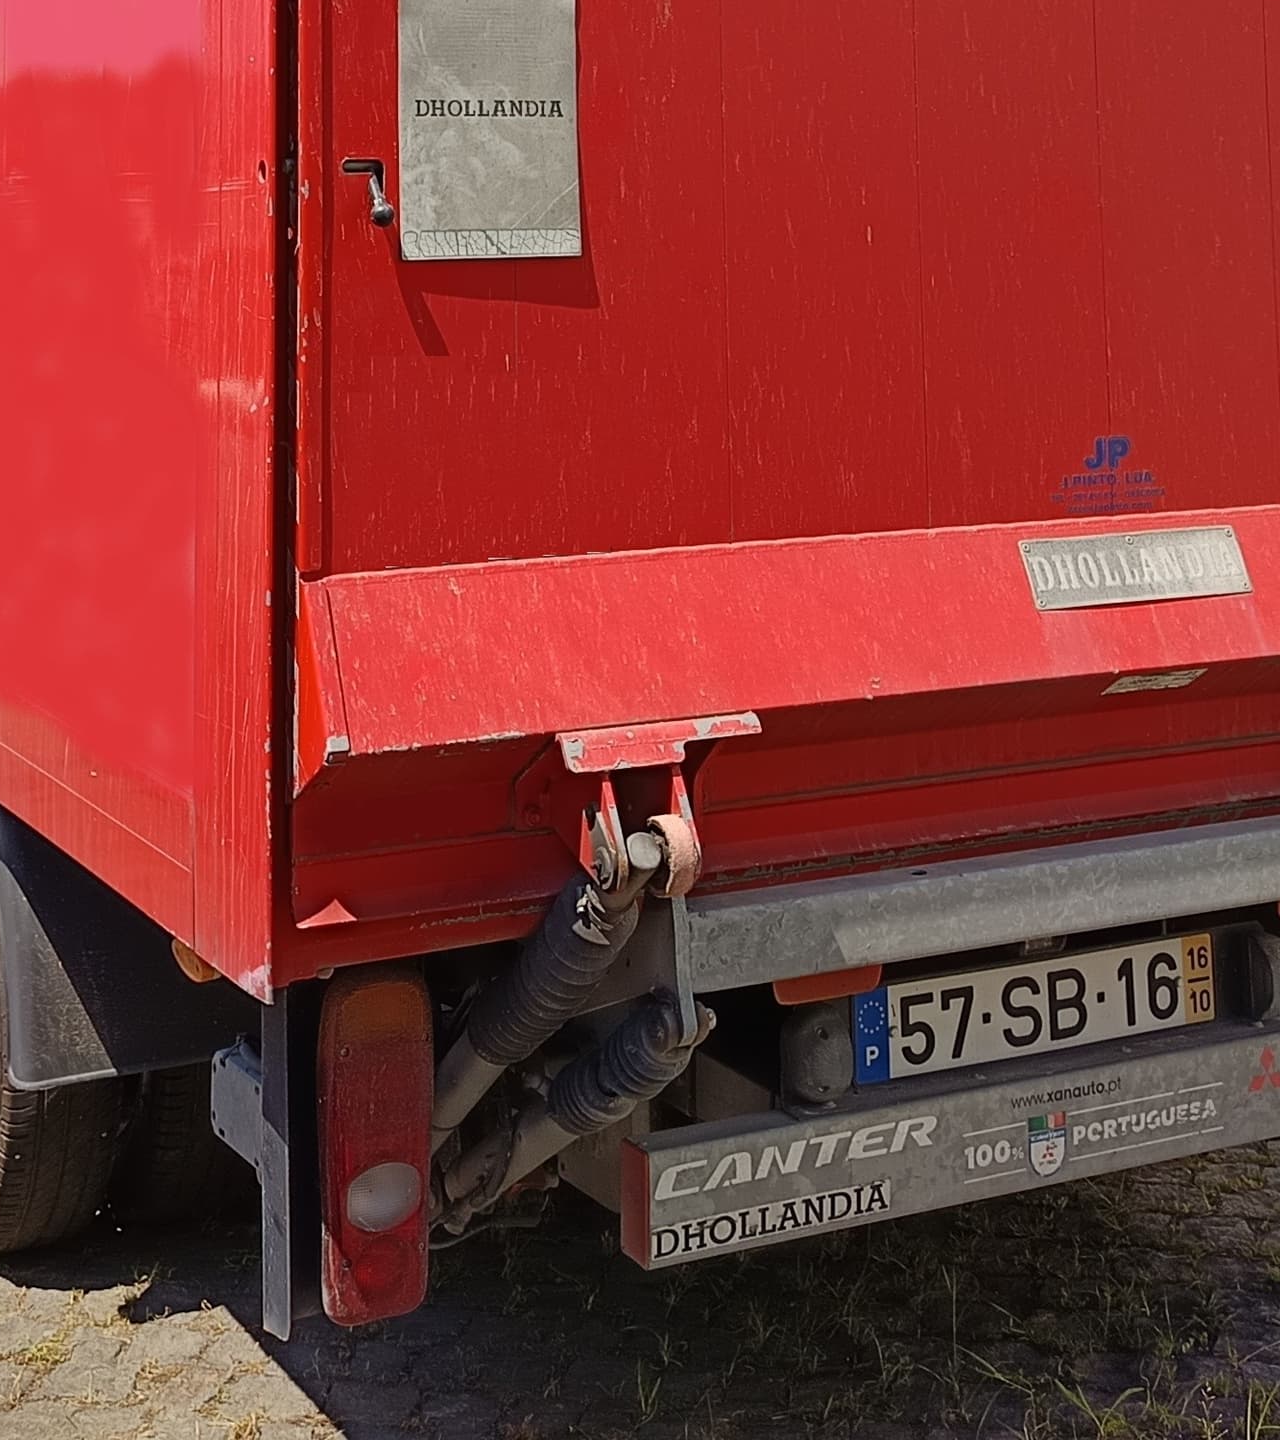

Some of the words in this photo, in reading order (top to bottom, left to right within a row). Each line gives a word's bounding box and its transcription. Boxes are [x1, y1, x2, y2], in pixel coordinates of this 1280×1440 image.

[414, 99, 565, 118] DHOLLANDIA
[1084, 435, 1131, 470] JP
[1028, 540, 1242, 594] DHOLLANDIA
[1186, 945, 1209, 971] 16
[1190, 987, 1211, 1014] 10
[865, 1046, 880, 1067] P
[1010, 1076, 1121, 1110] www.xanauto.pt
[963, 1139, 1024, 1170] 100%
[1072, 1098, 1217, 1146] PORTUGUESA
[654, 1115, 938, 1201] CANTER
[653, 1182, 889, 1259] DHOLLANDIA
